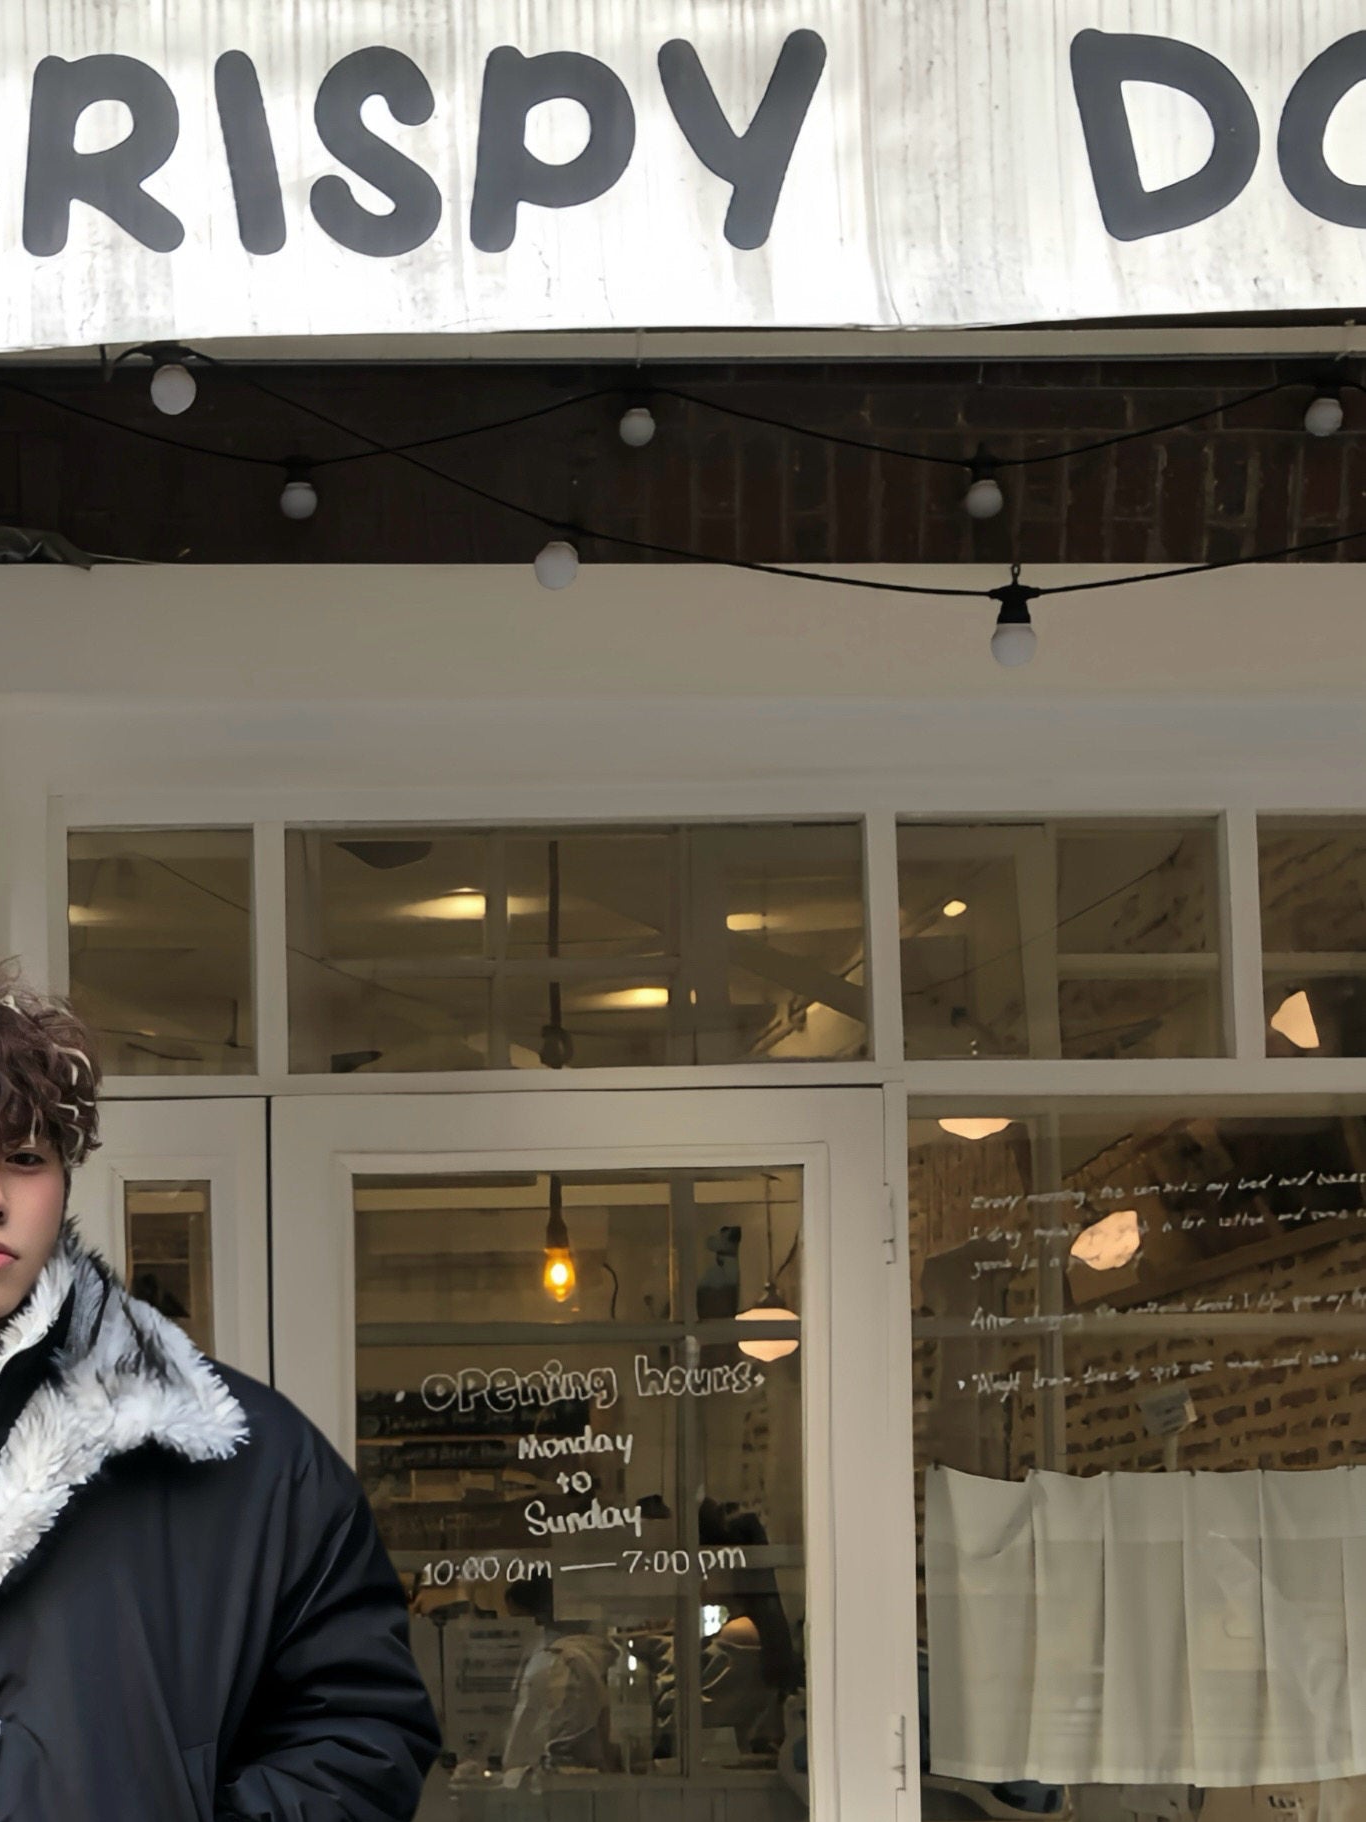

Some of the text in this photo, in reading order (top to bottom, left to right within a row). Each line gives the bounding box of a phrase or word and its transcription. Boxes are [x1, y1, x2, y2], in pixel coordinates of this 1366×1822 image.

[518, 1425, 633, 1464] Monday
[557, 1471, 591, 1493] to
[524, 1499, 642, 1537] Sunday
[421, 1556, 500, 1586] 10:00
[506, 1560, 552, 1582] am
[622, 1550, 690, 1575] 7:00
[698, 1547, 747, 1580] pm
